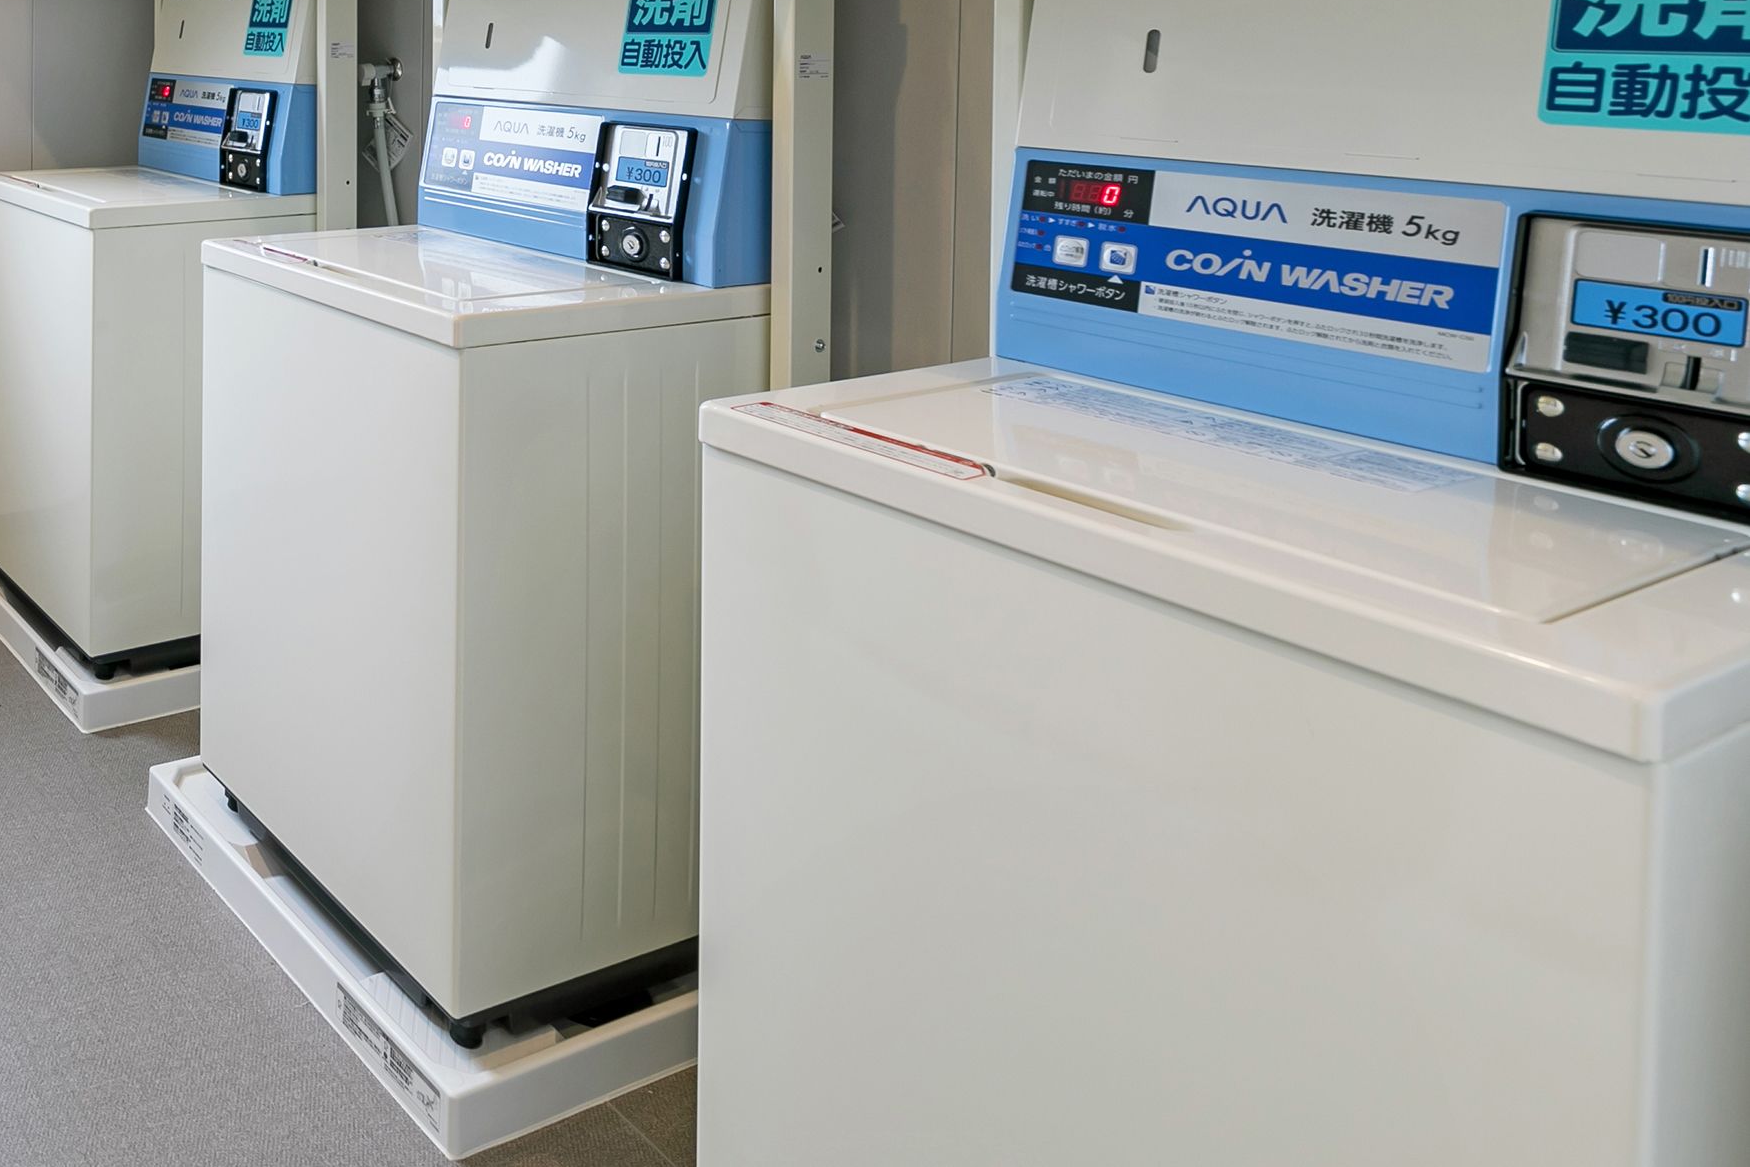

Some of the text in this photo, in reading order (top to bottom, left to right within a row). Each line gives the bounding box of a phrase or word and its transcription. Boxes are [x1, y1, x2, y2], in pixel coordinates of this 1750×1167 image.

[244, 31, 286, 53] 自動投入
[621, 38, 707, 71] 自動投入
[179, 89, 199, 99] AQUA
[1546, 61, 1750, 123] 自動投
[193, 113, 224, 128] WASHER
[464, 116, 472, 129] 0
[493, 120, 587, 143] AQUA 洗濯機 5kg
[524, 156, 582, 179] WASHER
[626, 166, 661, 183] ¥300
[1058, 169, 1139, 184] ただいまの金額 円
[1103, 186, 1120, 205] 0
[1124, 209, 1135, 219] 分
[1185, 195, 1461, 246] AQUA 洗濯機 5kg
[1025, 274, 1126, 302] 洗濯槽シャワーボタン
[1280, 264, 1455, 310] WASHER
[1604, 299, 1722, 338] ¥300
